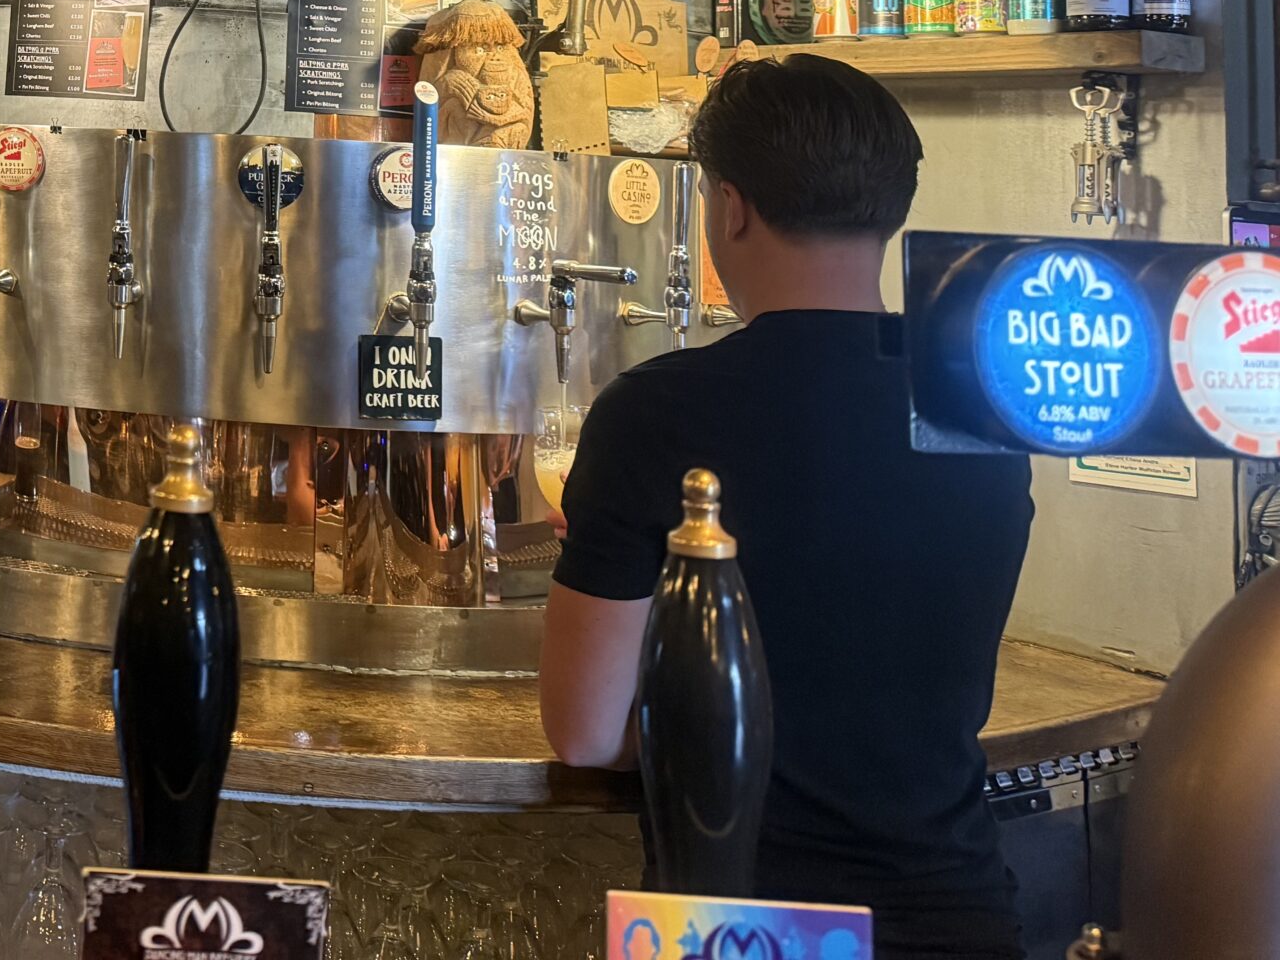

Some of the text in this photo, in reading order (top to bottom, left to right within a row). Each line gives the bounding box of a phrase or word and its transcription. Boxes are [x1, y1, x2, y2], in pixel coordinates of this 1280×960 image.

[0, 137, 27, 155] Stiegl
[496, 162, 553, 198] Rings
[625, 180, 648, 192] LITTLE
[423, 180, 433, 217] PERONI
[499, 196, 557, 212] around
[621, 191, 651, 205] CASINO
[513, 210, 540, 222] The
[497, 274, 528, 283] LUNAR
[1222, 290, 1280, 340] Stieg
[1007, 309, 1132, 349] BIG BAD
[374, 345, 381, 365] I
[372, 368, 433, 390] DRINK
[1023, 360, 1124, 399] STOUT
[365, 393, 440, 409] CRAFT BEER
[1037, 405, 1112, 422] 6.8% ABV
[1052, 426, 1093, 442] Stout
